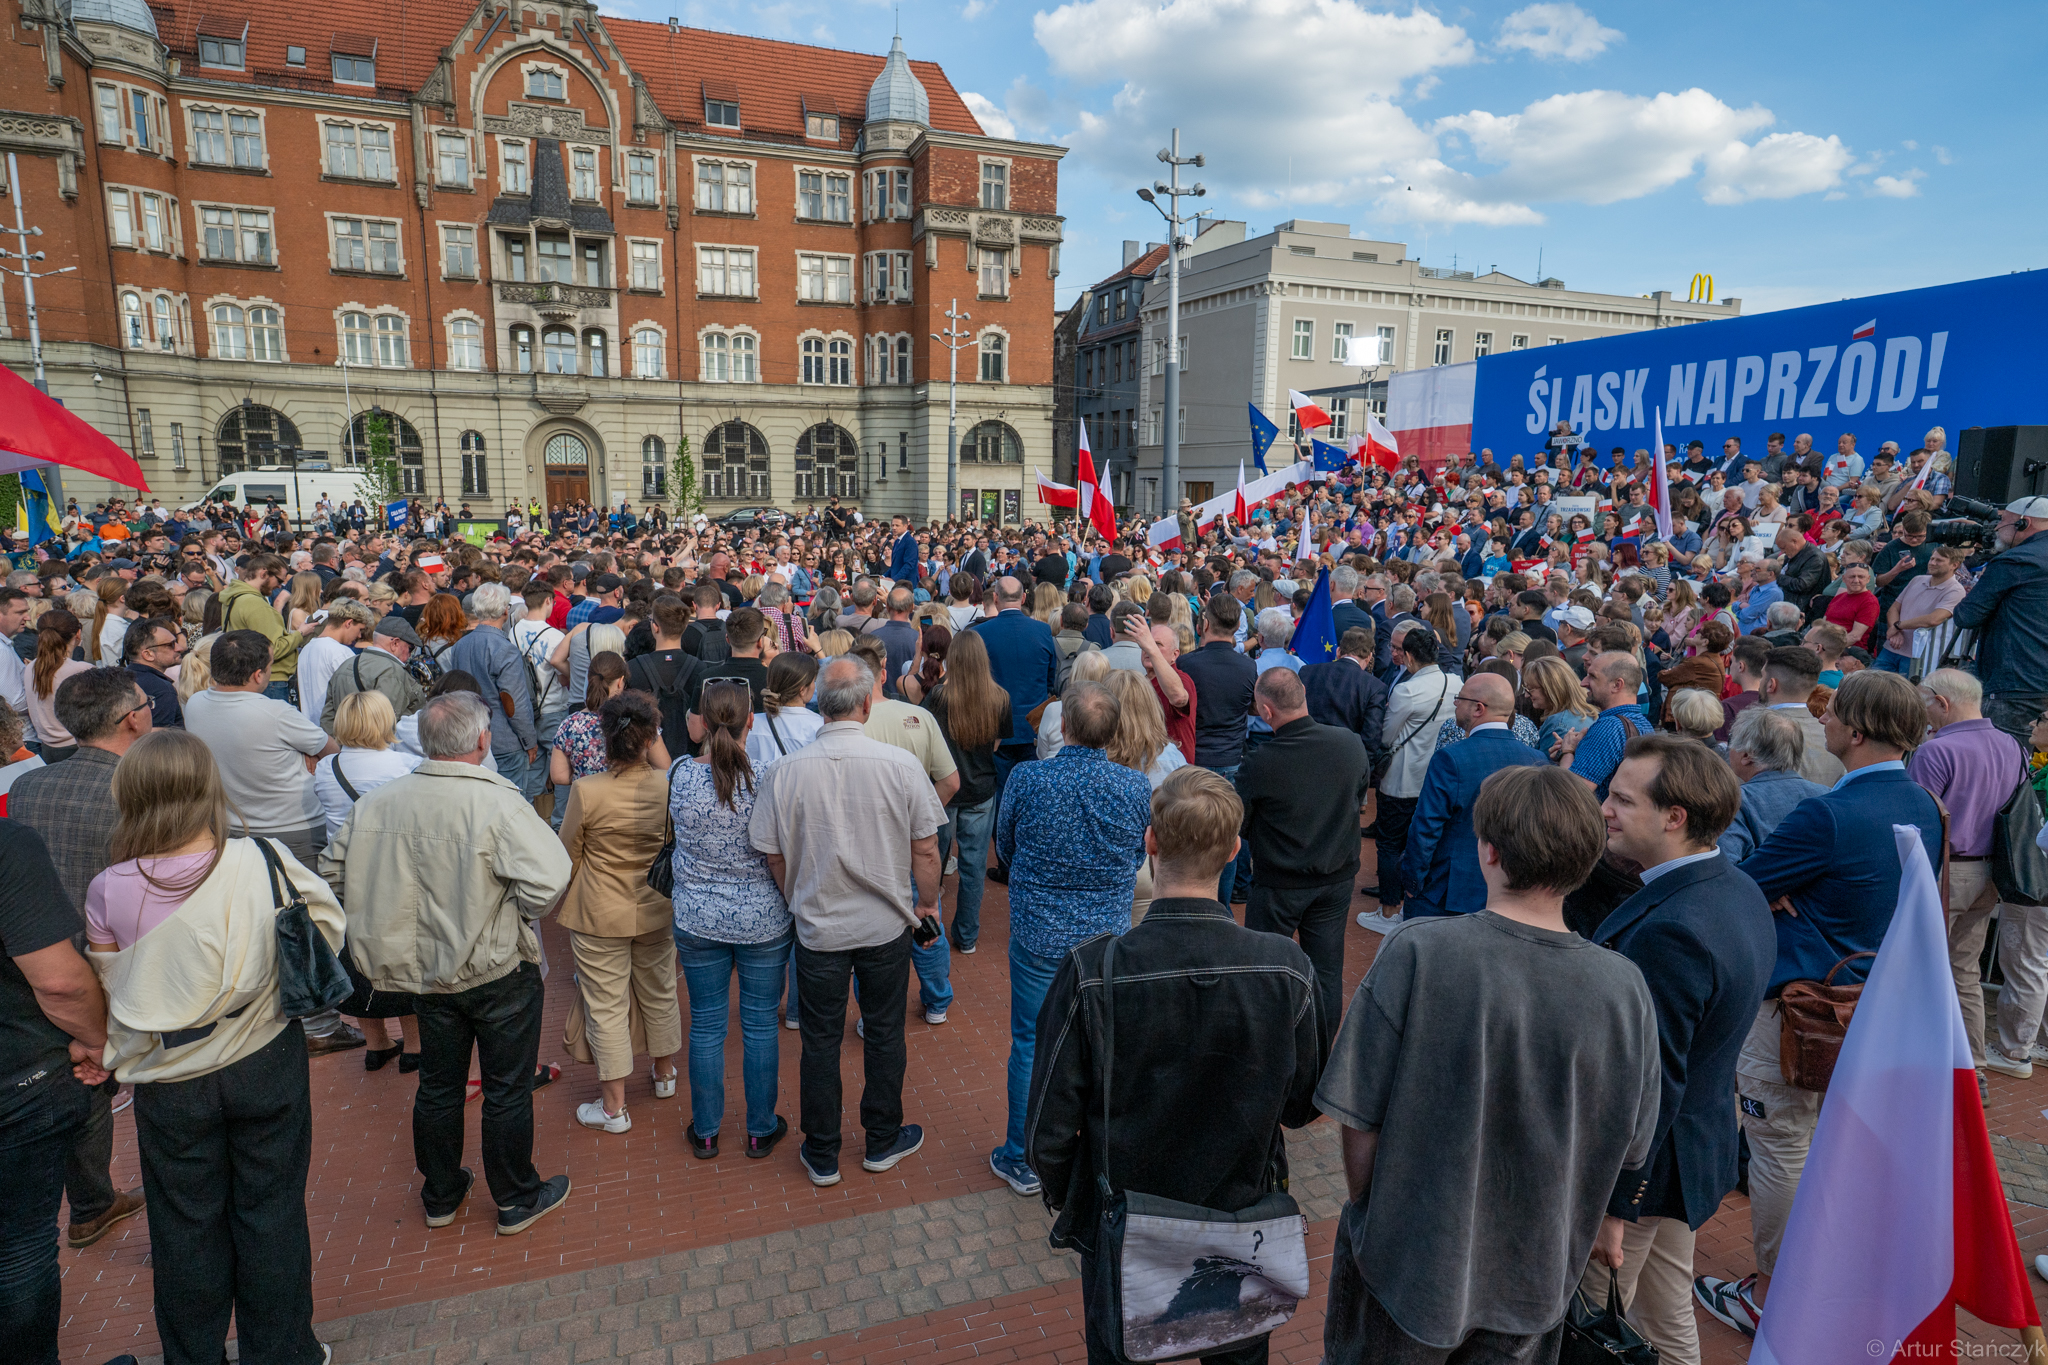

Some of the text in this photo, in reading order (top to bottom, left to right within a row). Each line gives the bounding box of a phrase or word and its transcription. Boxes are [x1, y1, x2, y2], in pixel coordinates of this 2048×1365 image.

[1525, 318, 1949, 450] ŚLĄSK NAPRZÓD!
[1552, 436, 1582, 445] JAWORZNO
